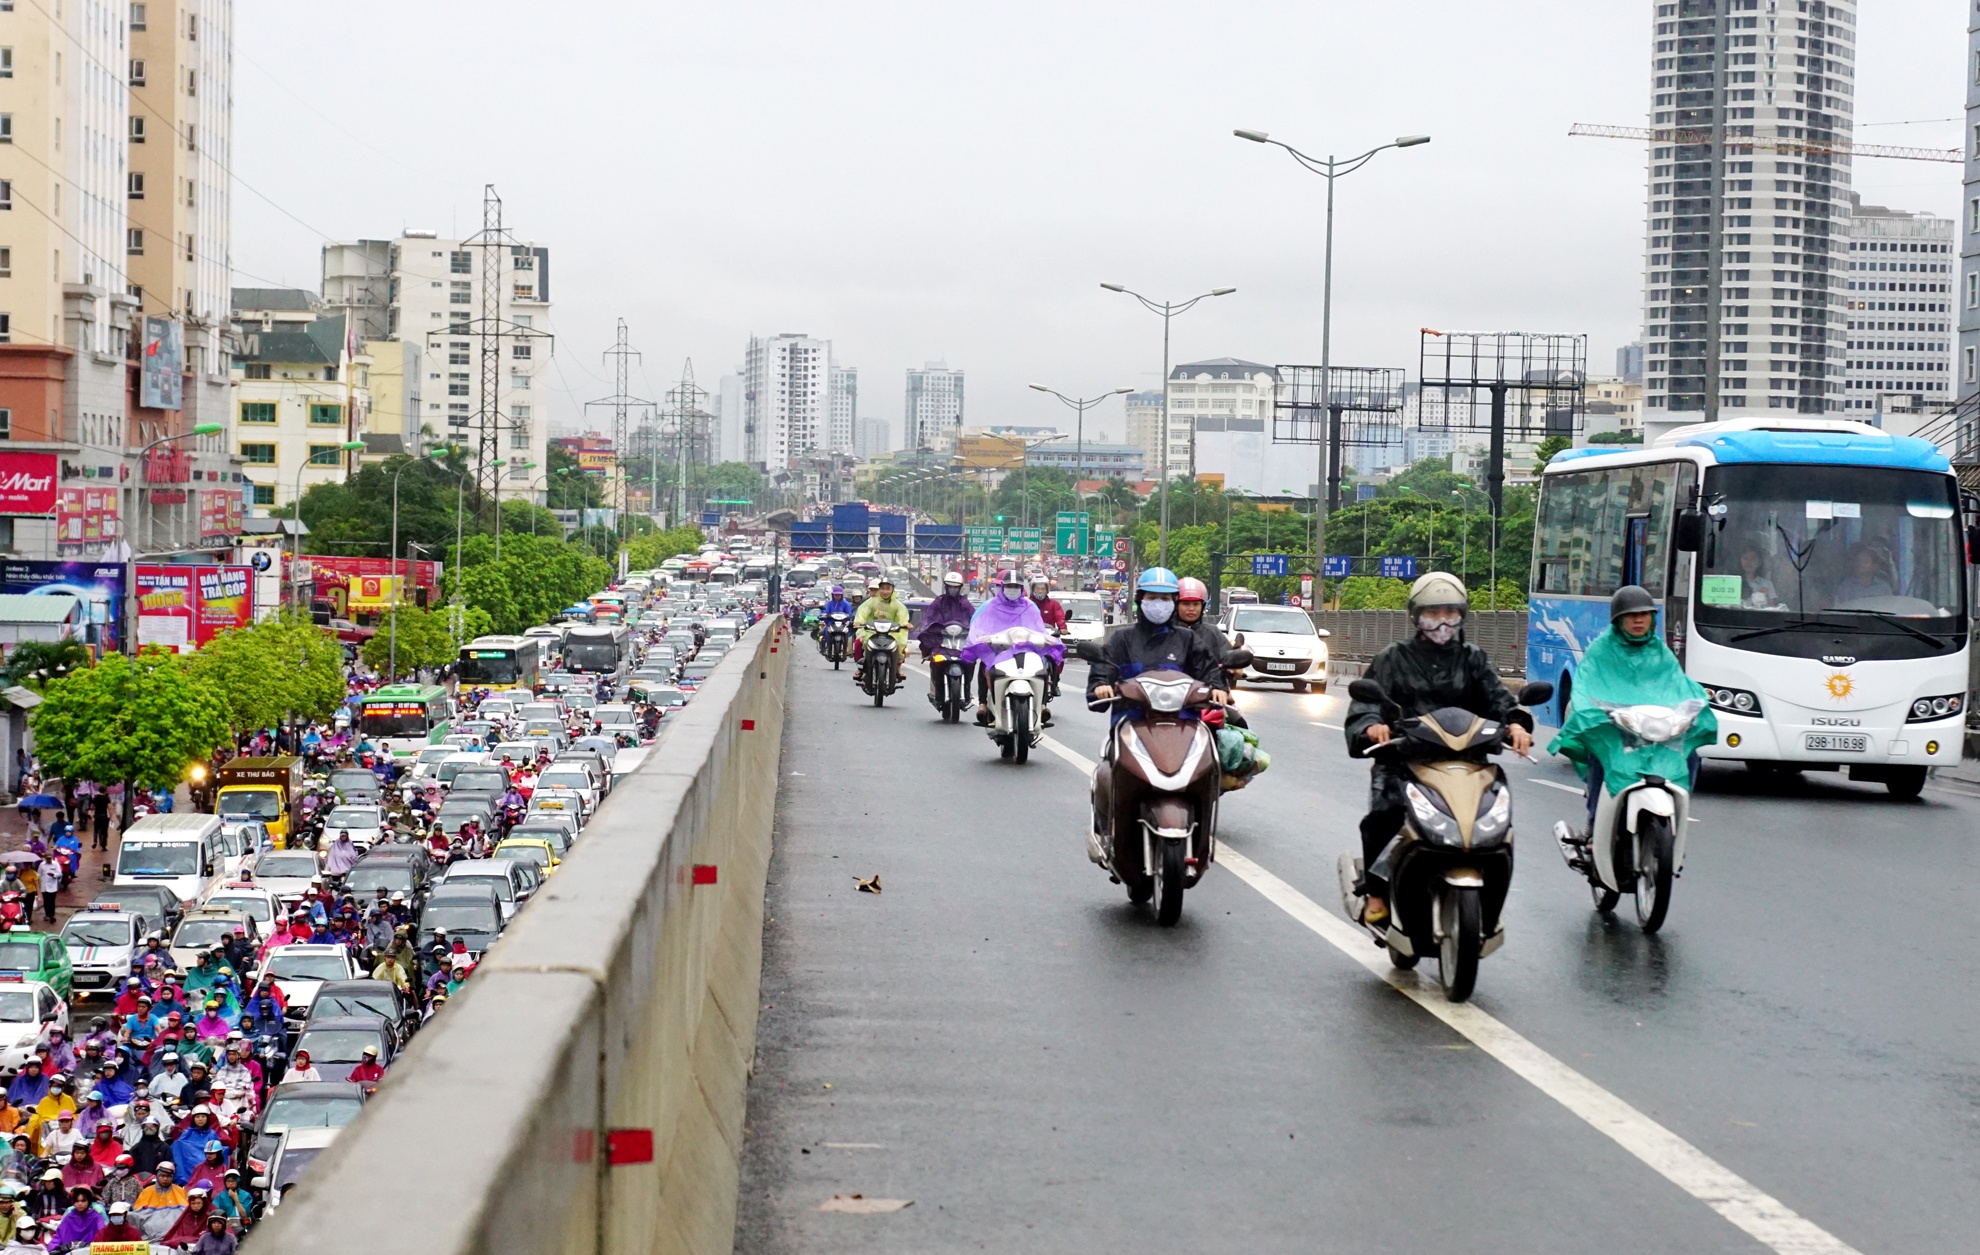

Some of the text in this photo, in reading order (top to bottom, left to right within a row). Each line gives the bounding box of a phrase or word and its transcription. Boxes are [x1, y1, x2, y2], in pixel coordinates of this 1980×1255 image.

[1024, 542, 1038, 552] DỊCH
[155, 575, 188, 587] TẬN NHÀ
[200, 570, 245, 586] BÁN HÀNG
[224, 582, 247, 597] GÓP
[140, 590, 184, 610] 100KM
[1822, 656, 1856, 664] SAMCO
[1811, 717, 1860, 726] ISUZU
[115, 1244, 134, 1252] LONG
